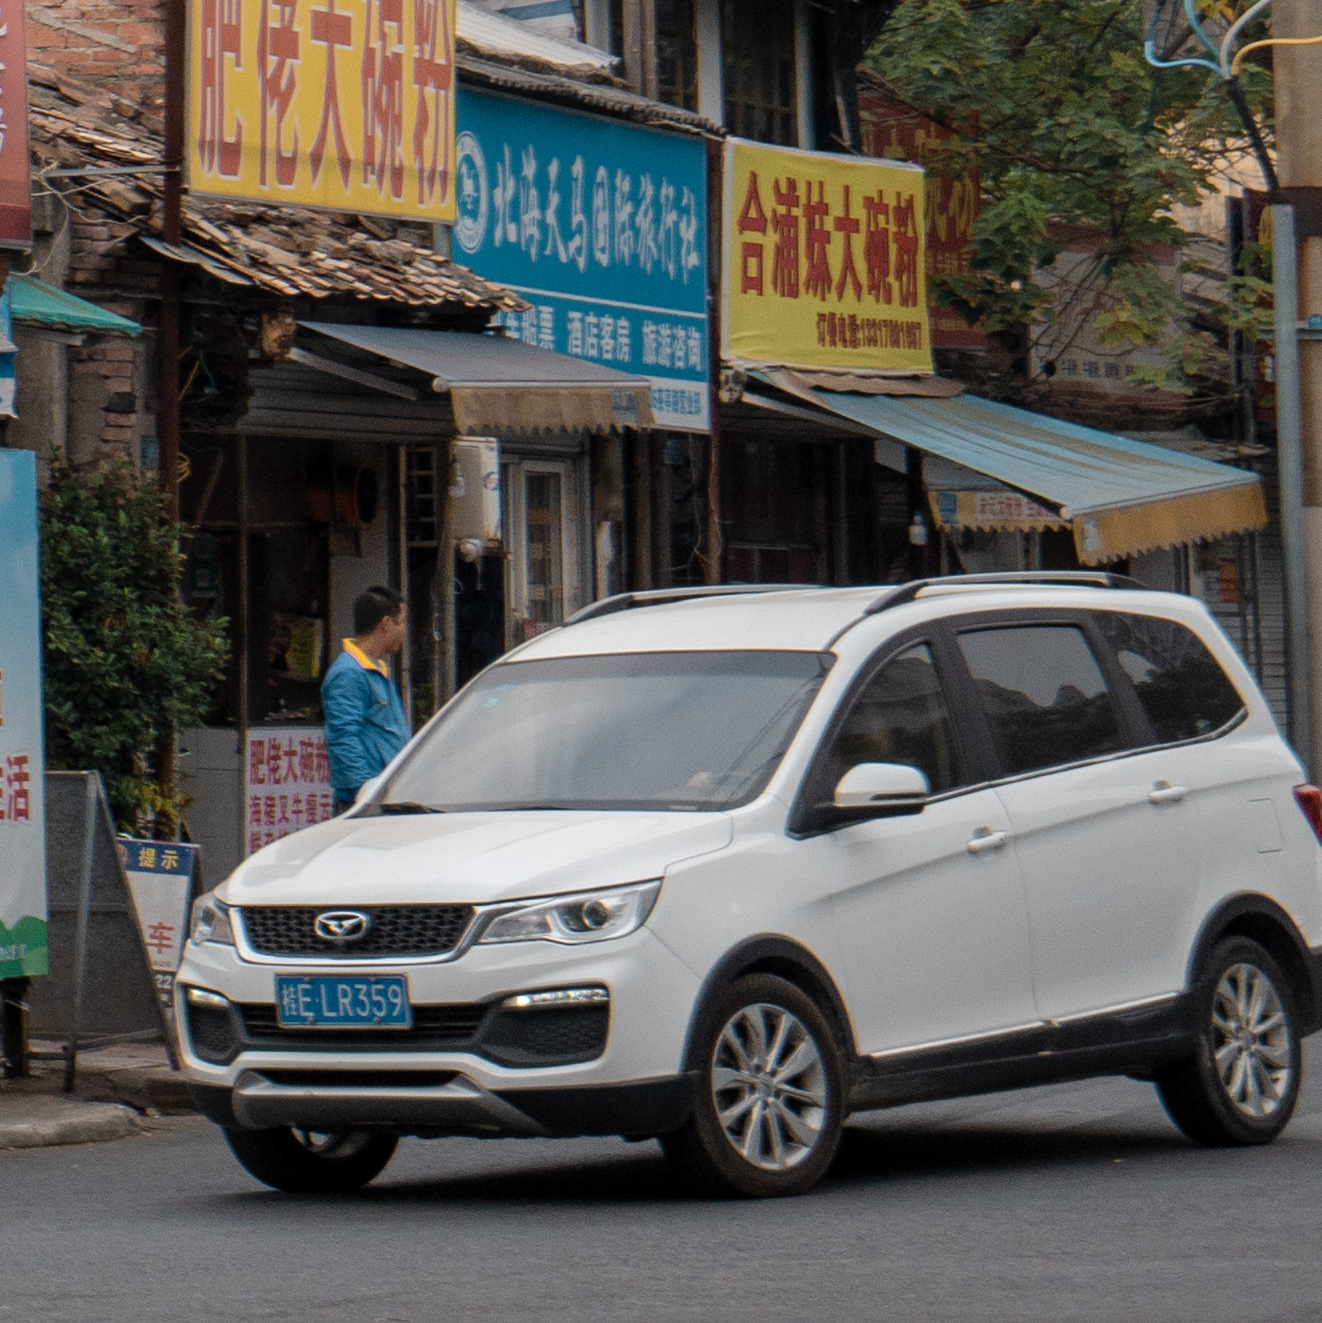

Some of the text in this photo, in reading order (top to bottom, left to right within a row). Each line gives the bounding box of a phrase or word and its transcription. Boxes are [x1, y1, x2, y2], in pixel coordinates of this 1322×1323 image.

[568, 311, 630, 363] 酒店客房
[642, 320, 701, 372] 旅游咨询
[138, 846, 179, 870] 提示
